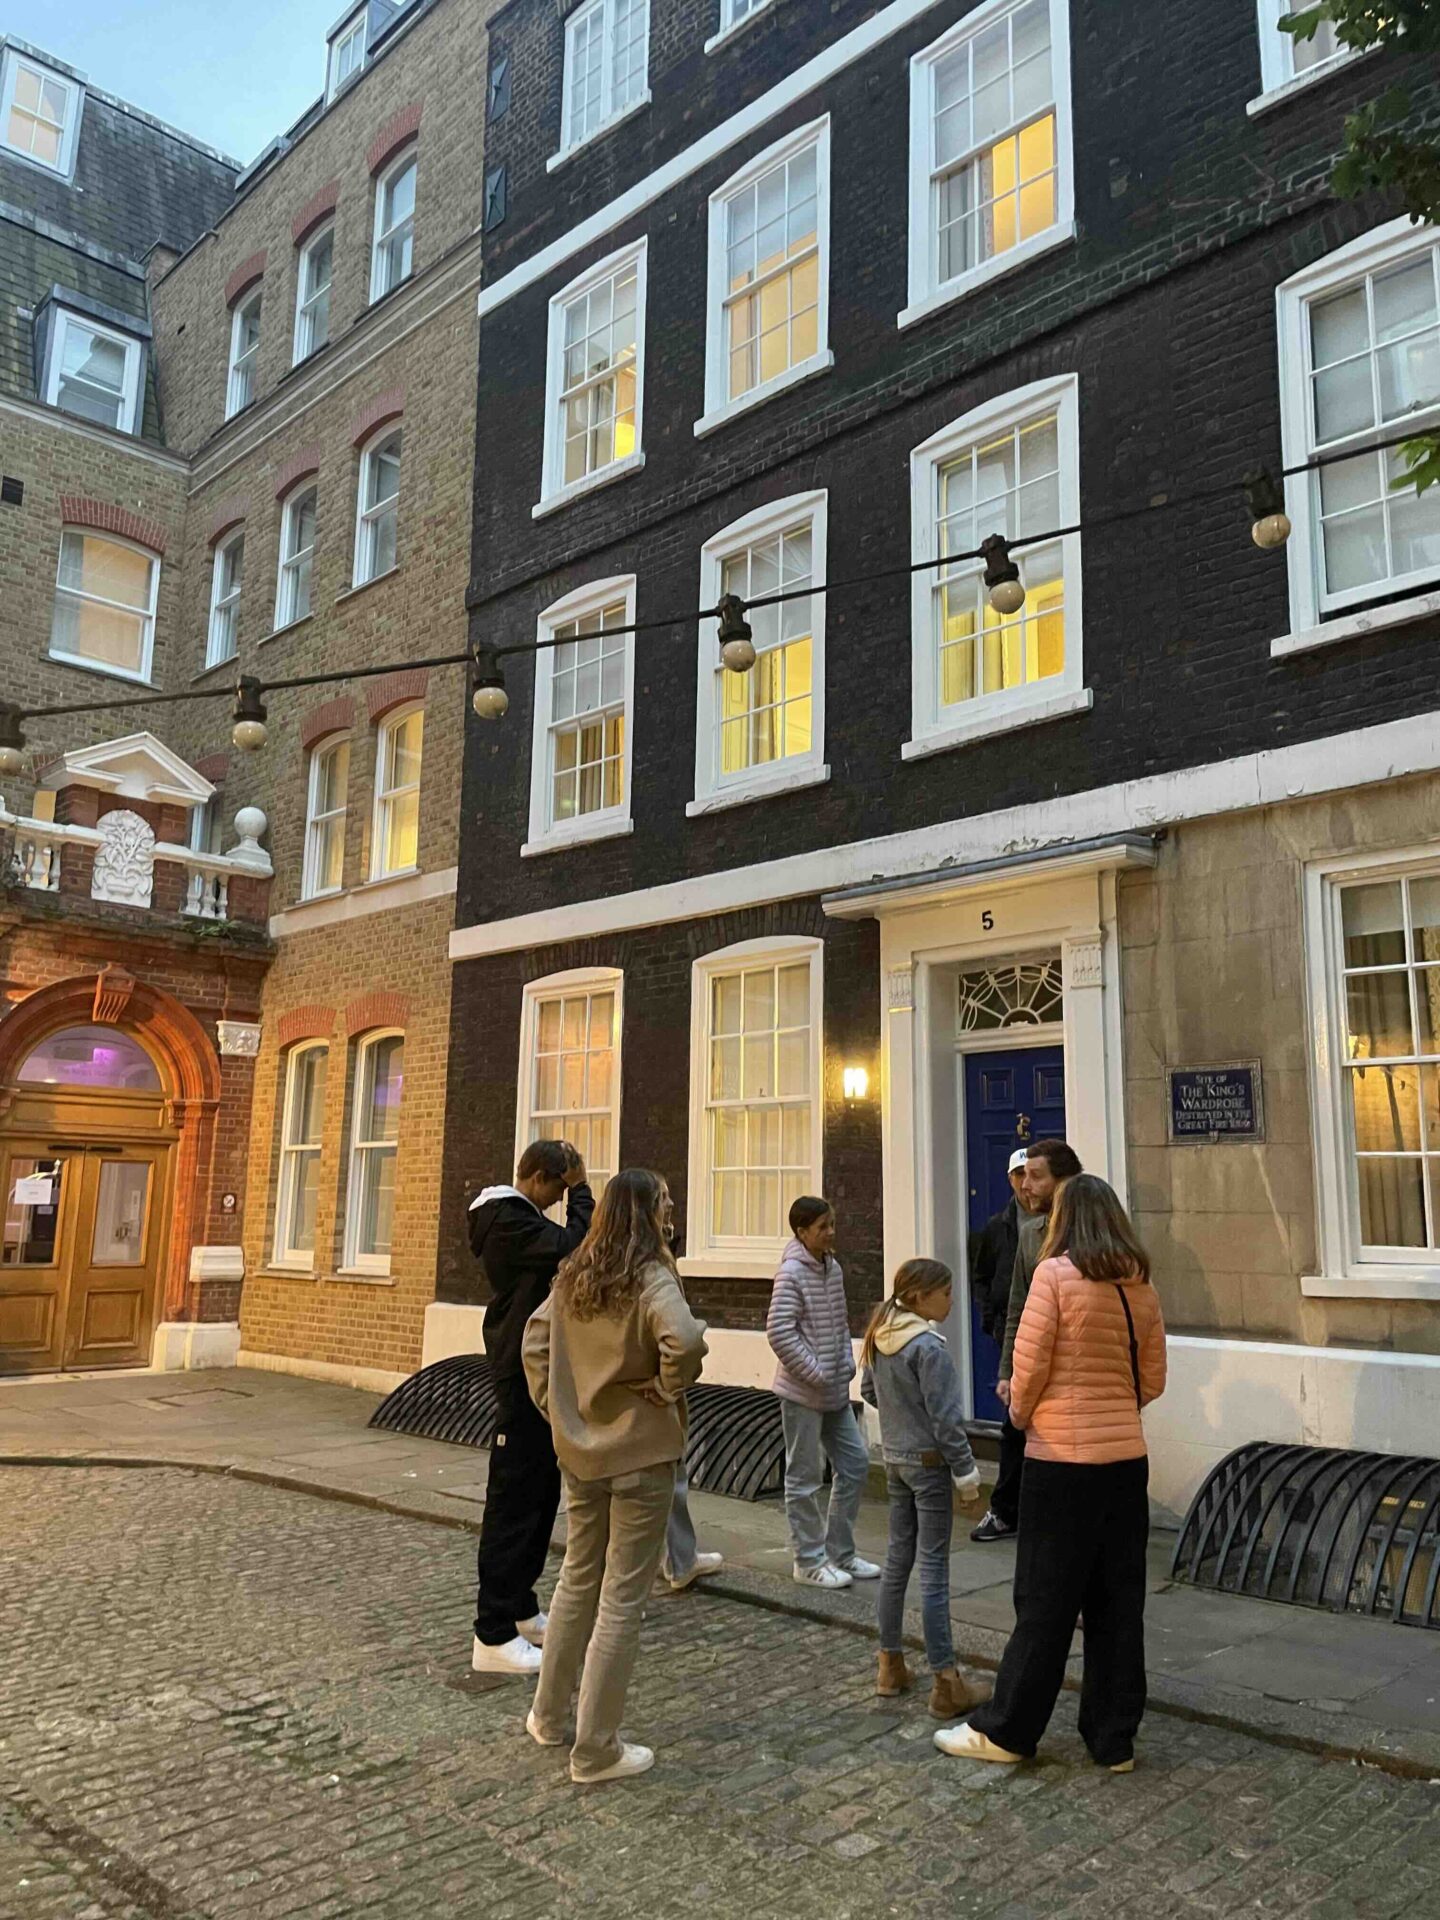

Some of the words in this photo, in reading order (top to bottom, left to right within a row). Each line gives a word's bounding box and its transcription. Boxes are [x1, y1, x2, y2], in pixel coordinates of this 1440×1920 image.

[982, 910, 994, 931] 5
[1181, 1085, 1203, 1098] THE
[1207, 1083, 1245, 1097] KING'S
[1181, 1098, 1245, 1109] WARDROBE
[1177, 1121, 1207, 1129] GREAT
